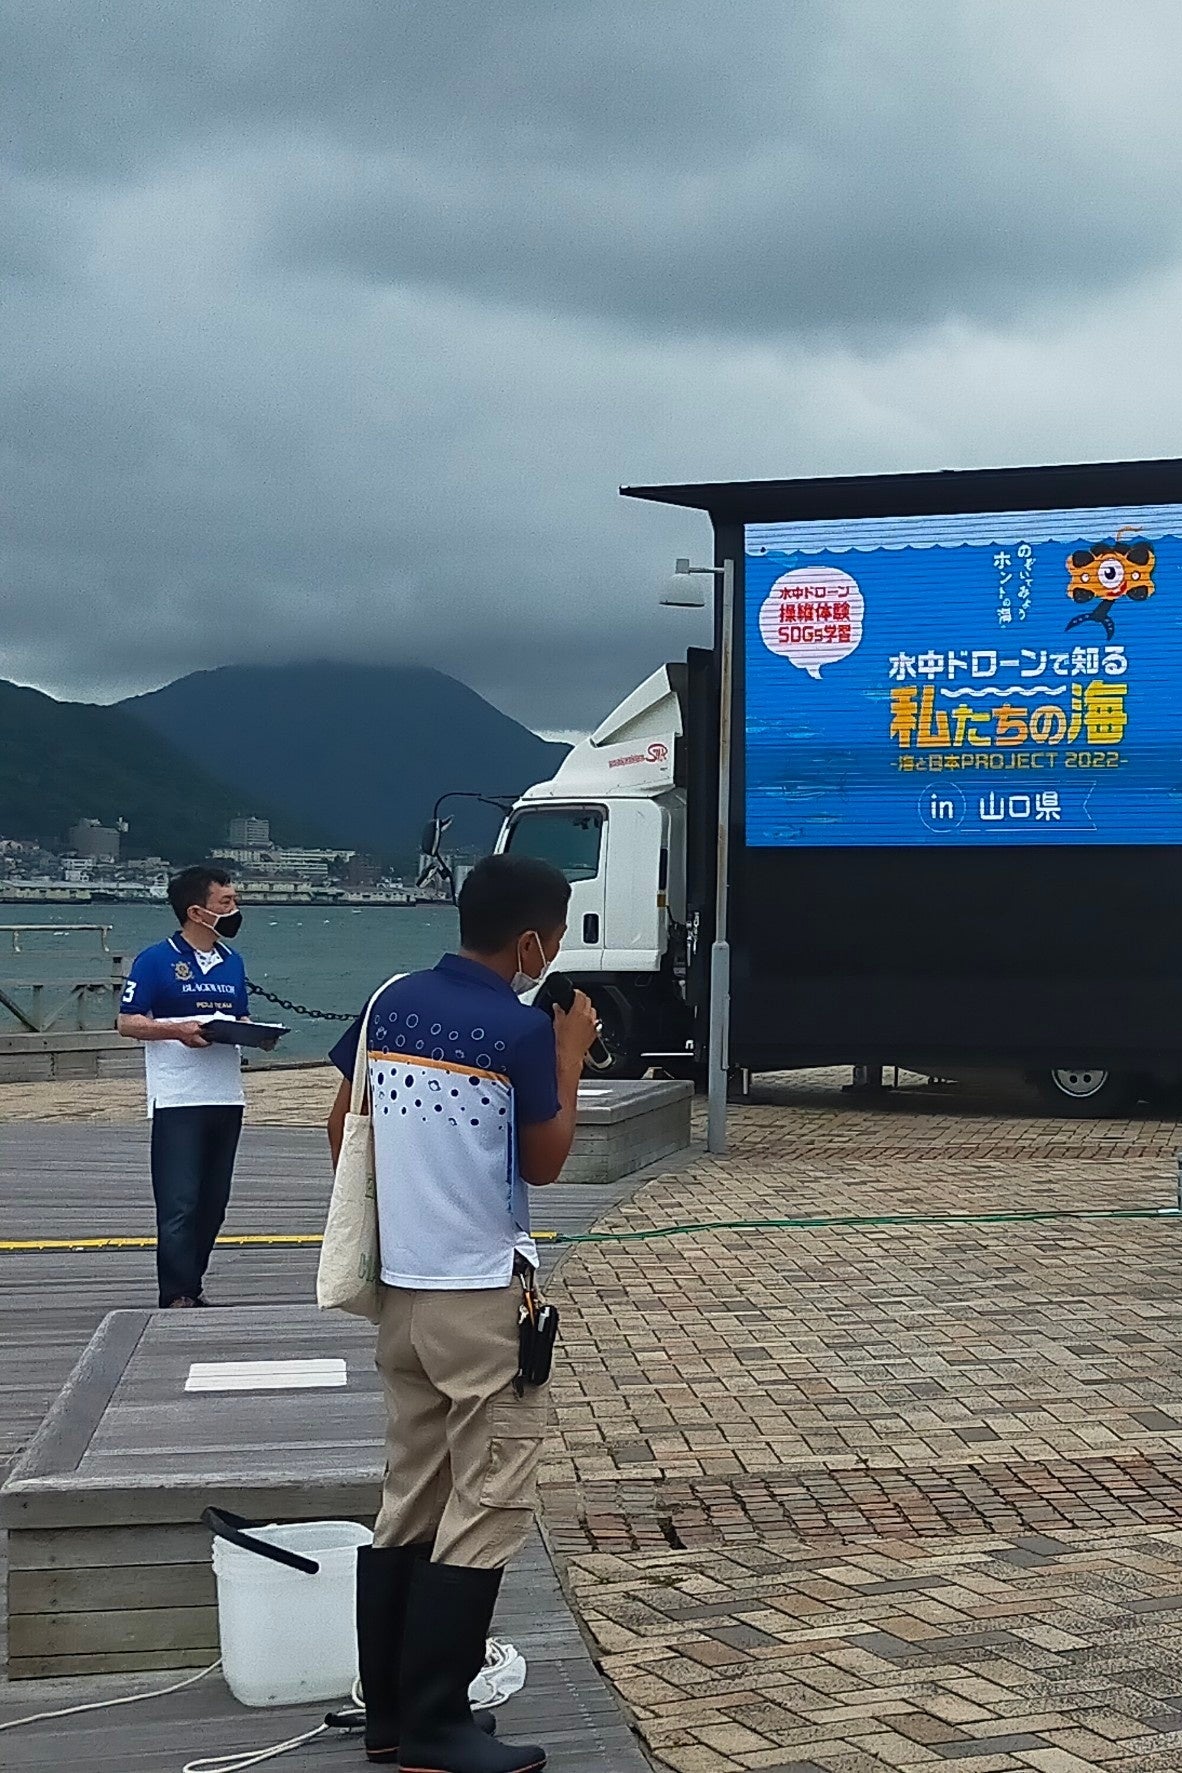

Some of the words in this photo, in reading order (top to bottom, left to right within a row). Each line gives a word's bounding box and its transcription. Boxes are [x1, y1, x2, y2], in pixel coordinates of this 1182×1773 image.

[779, 586, 850, 600] 水中ドローン
[779, 601, 851, 623] 操縦体験
[778, 624, 851, 643] SDGs学習
[888, 646, 1128, 681] 水中ドローンで知る
[889, 680, 1128, 748] 私たちの海
[930, 793, 954, 819] in
[979, 790, 1062, 821] 山口県
[122, 980, 138, 1003] 3
